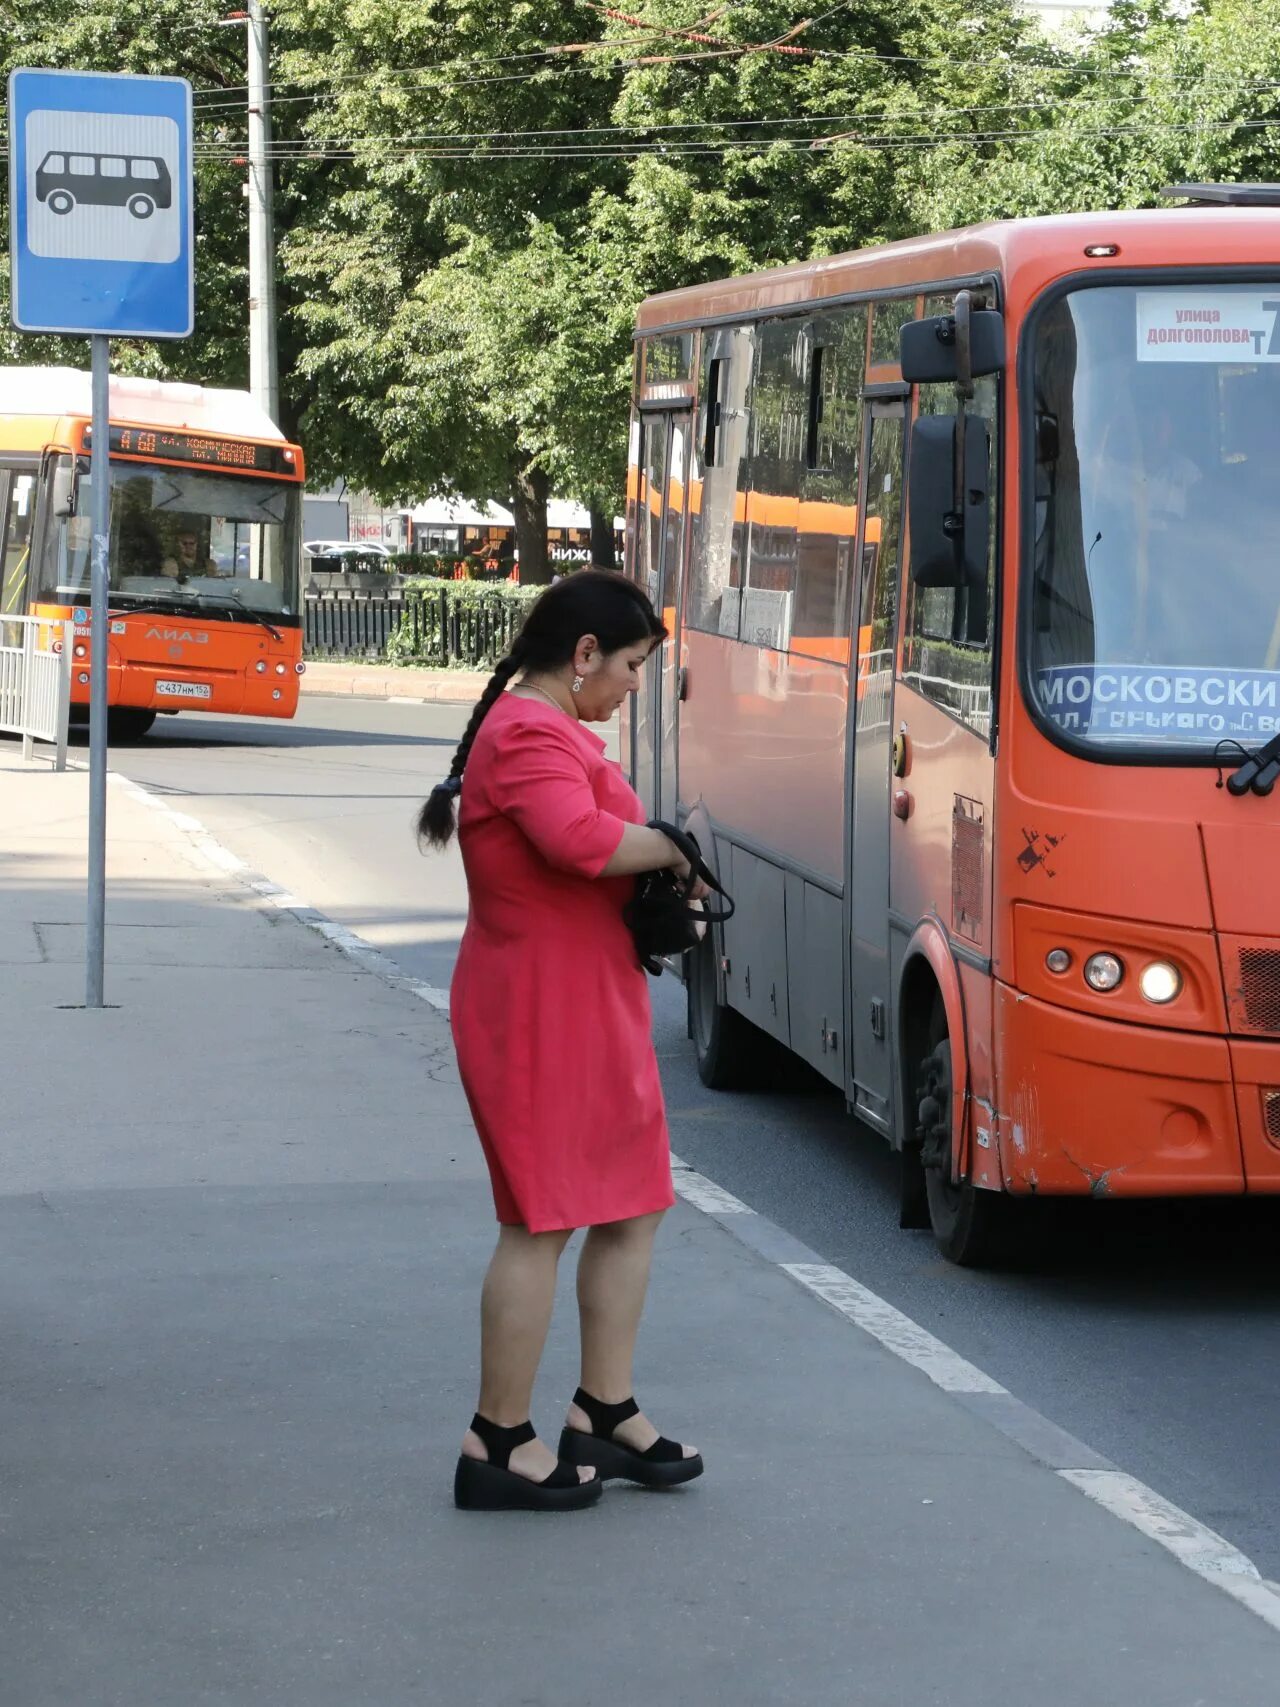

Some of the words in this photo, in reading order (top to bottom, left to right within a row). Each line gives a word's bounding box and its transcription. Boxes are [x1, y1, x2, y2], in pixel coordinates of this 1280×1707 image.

[1175, 310, 1221, 324] улица
[1147, 328, 1249, 345] ДОЛГОПОЛОВА
[144, 628, 209, 644] ЛИАЗ
